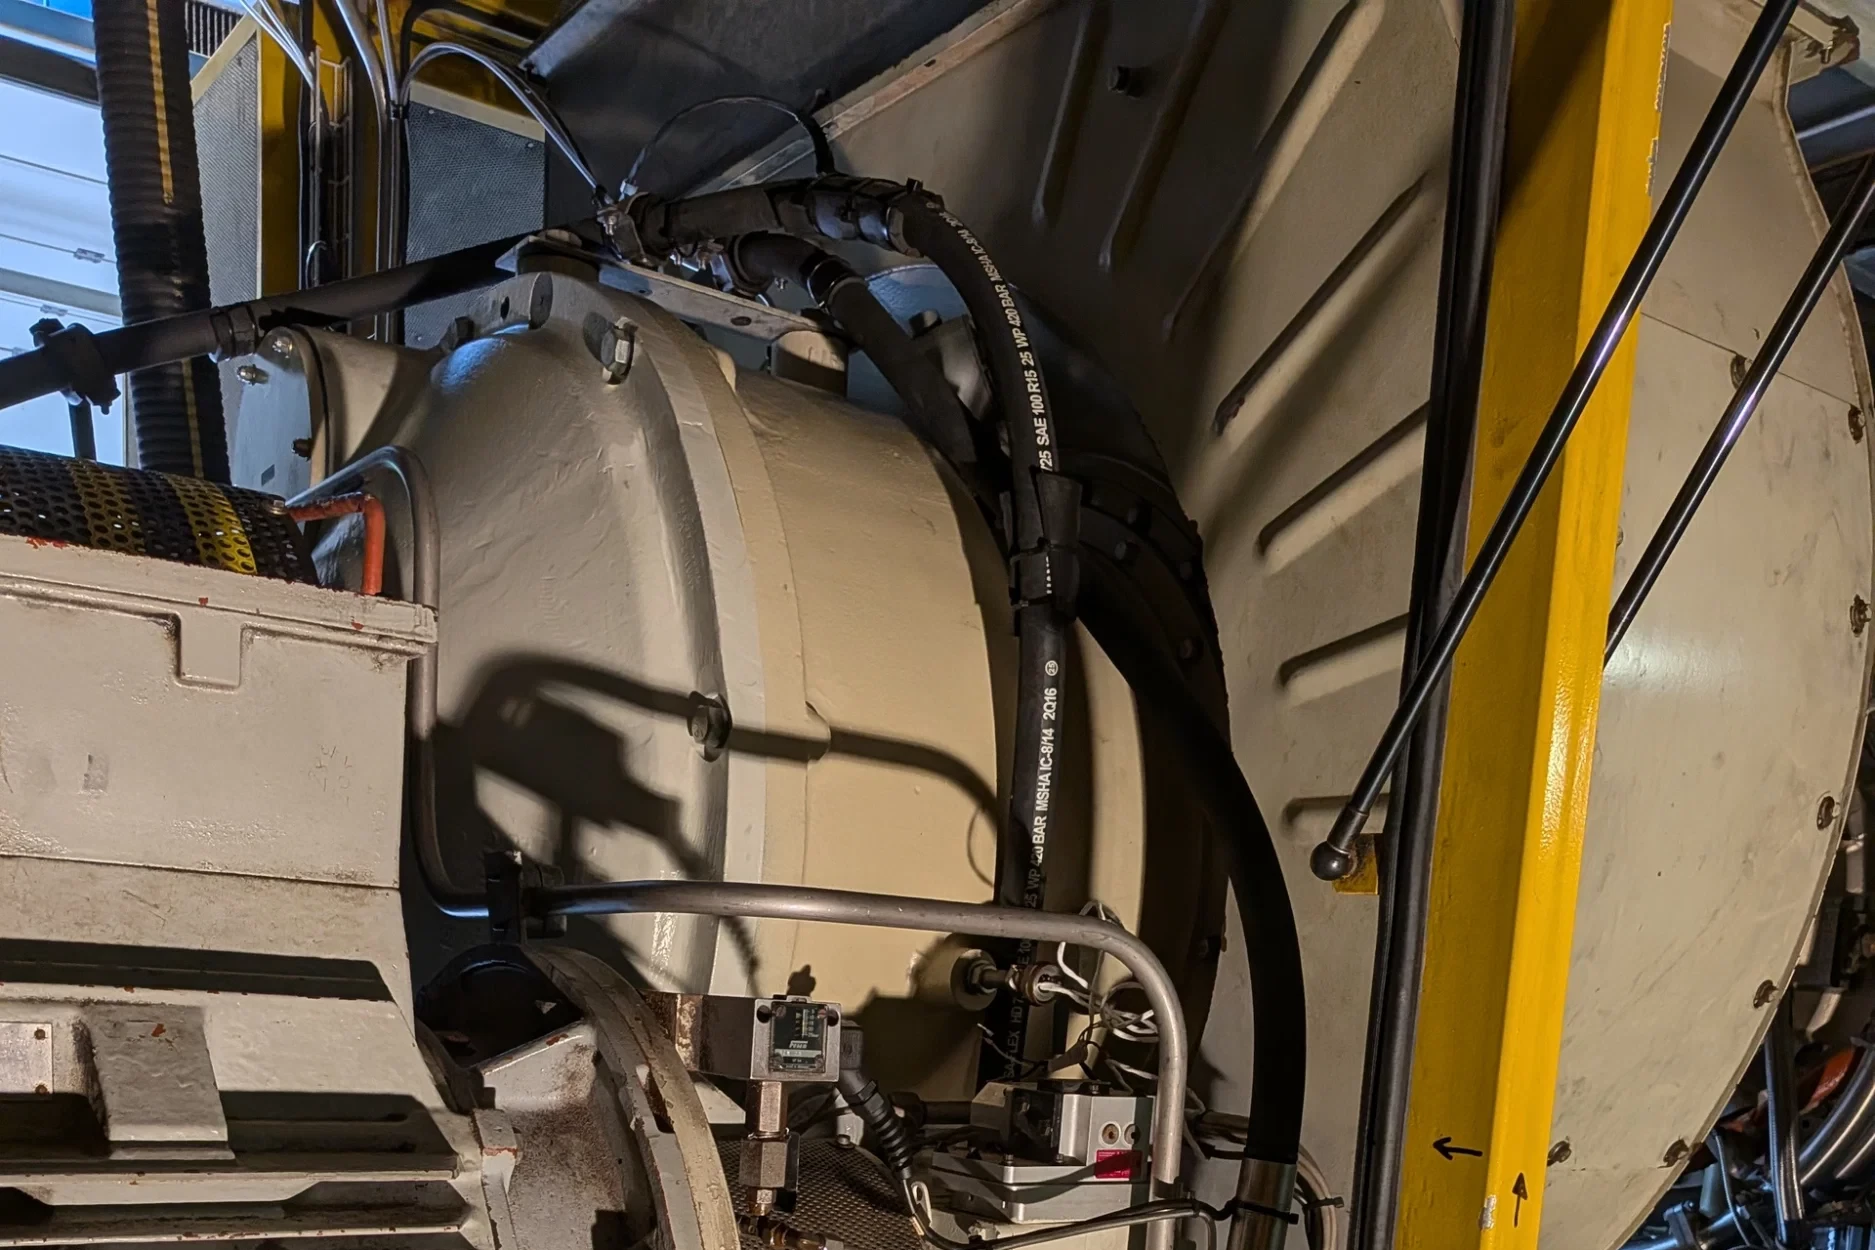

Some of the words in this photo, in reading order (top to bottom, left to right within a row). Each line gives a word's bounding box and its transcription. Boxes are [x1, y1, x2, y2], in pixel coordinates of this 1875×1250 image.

[978, 255, 1002, 281] MSHA
[994, 284, 1014, 307] BAR
[1005, 308, 1021, 327] 420
[1012, 328, 1029, 348] WP
[1020, 351, 1035, 367] 25
[1024, 370, 1041, 393] R15
[1030, 394, 1045, 415] 100
[1034, 418, 1050, 445] SAE
[1043, 687, 1058, 720] 2Q16
[1039, 728, 1055, 770] IC-8/14
[1036, 772, 1052, 811] MSHA
[1032, 815, 1047, 844] BAR
[1030, 845, 1044, 867] 420
[1028, 868, 1041, 889] WP
